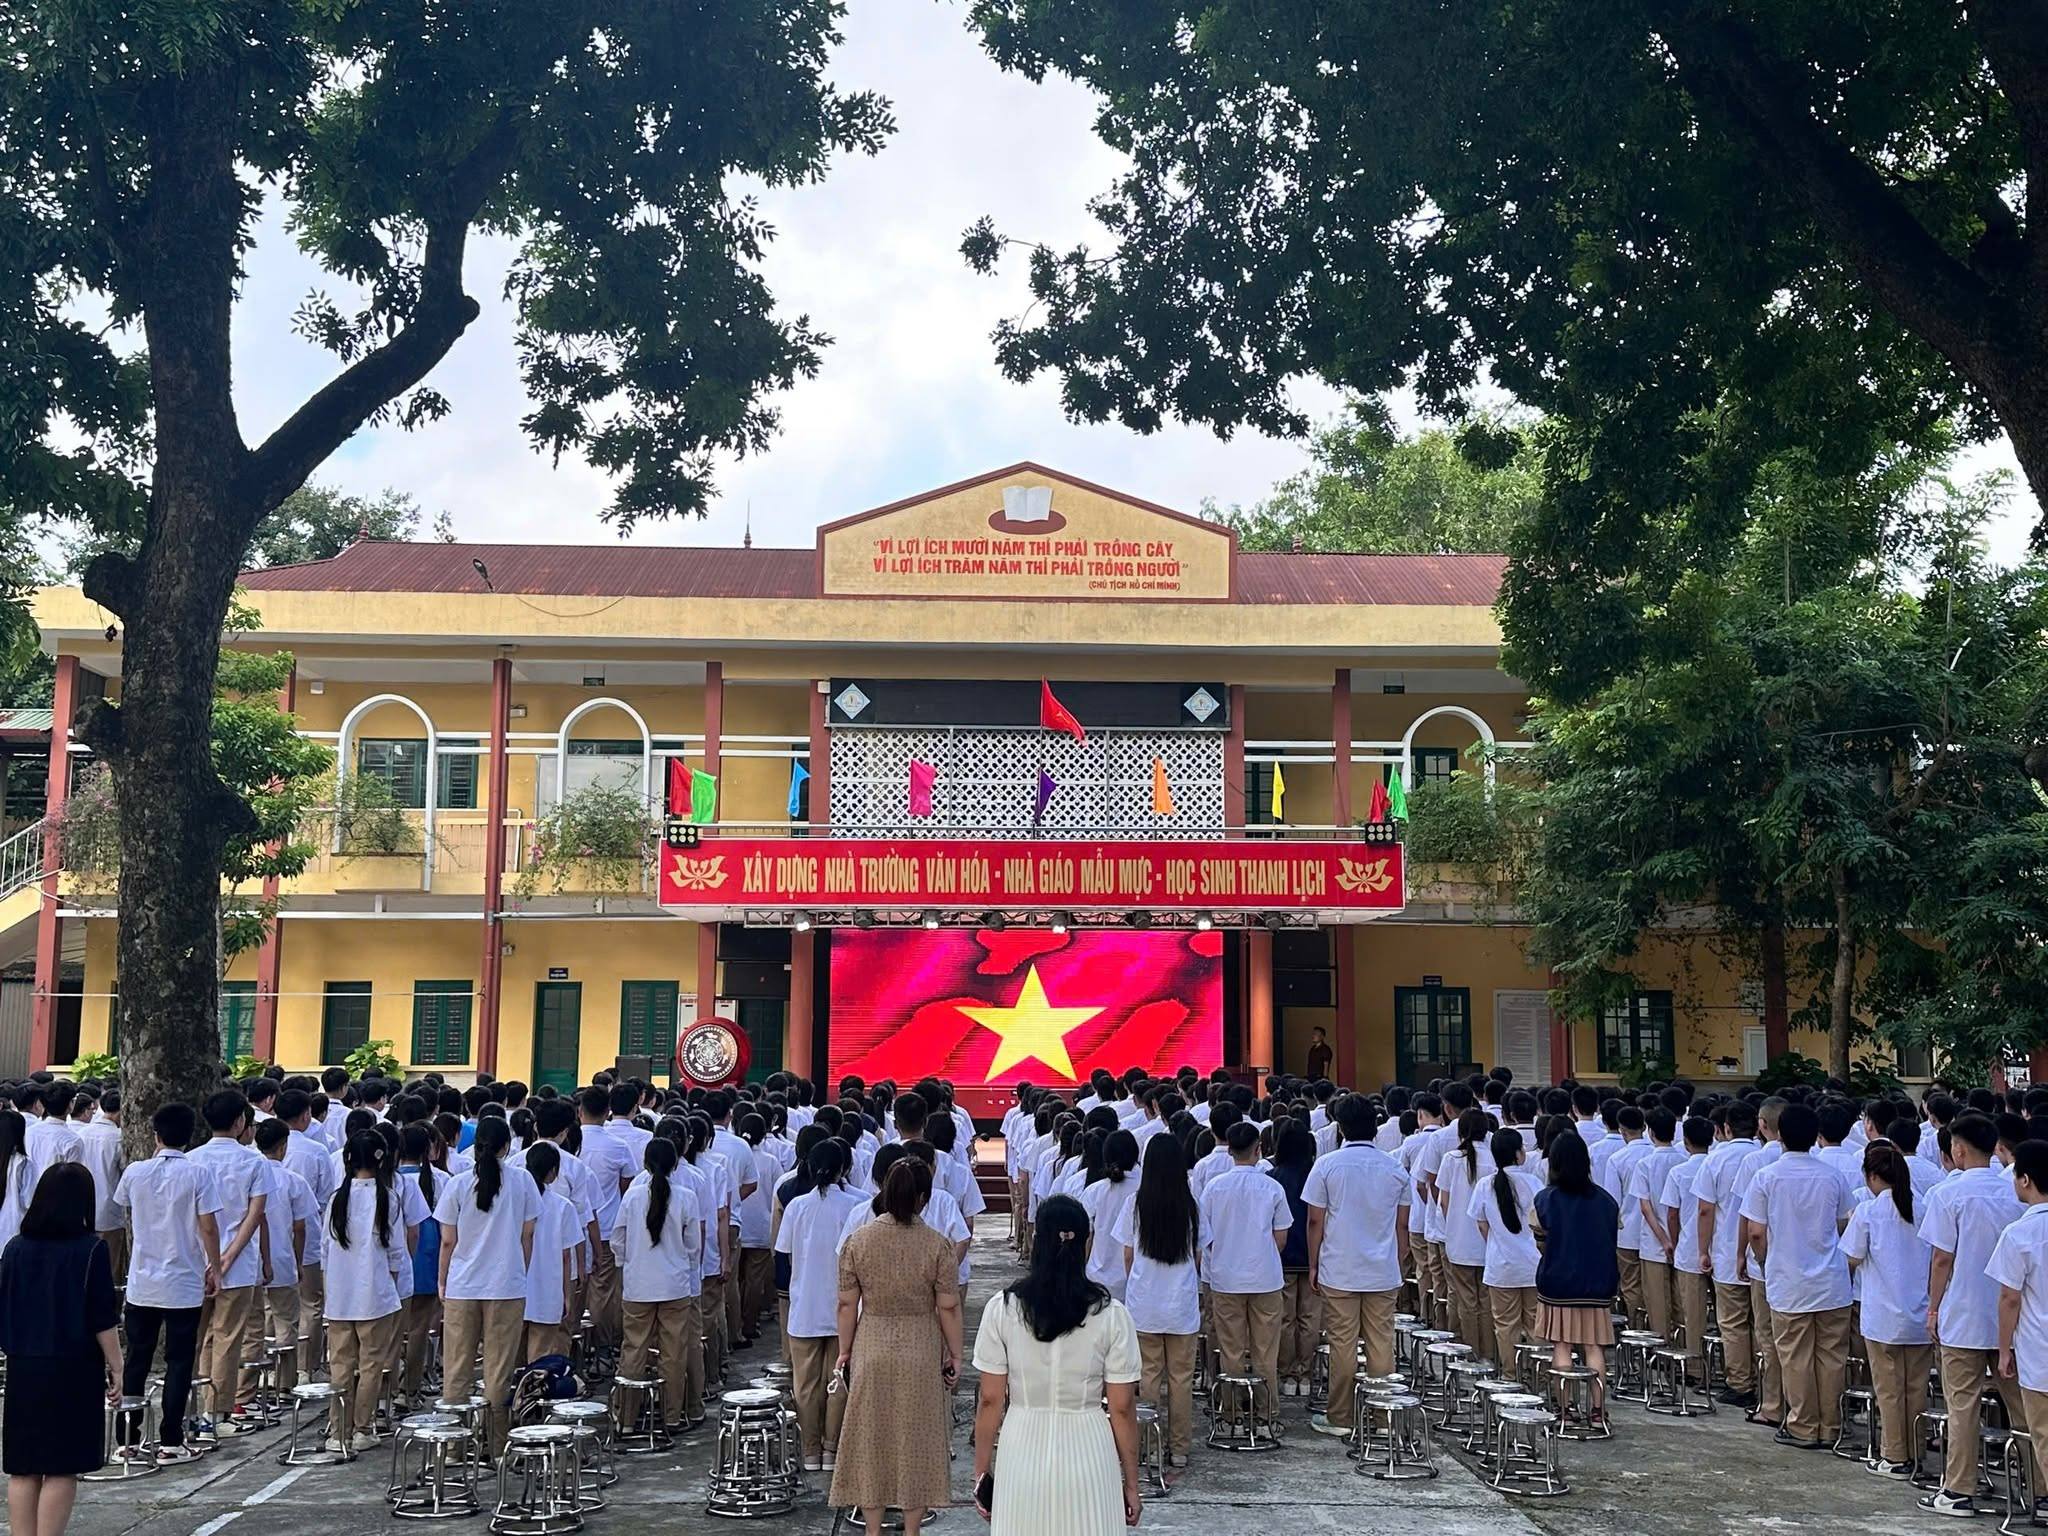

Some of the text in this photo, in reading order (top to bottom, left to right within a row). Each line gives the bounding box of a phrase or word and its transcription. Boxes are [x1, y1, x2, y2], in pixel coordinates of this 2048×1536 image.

[924, 536, 948, 555] ÍCH
[952, 536, 989, 556] MƯỜI
[992, 538, 1025, 556] NĂM
[1146, 541, 1174, 557] CÂY
[918, 554, 942, 574] ÍCH
[945, 557, 984, 575] TRĂM
[988, 557, 1022, 575] NĂM
[742, 850, 773, 893] XÂY
[776, 853, 818, 899] DỰNG
[824, 850, 856, 893] NHÀ
[860, 848, 919, 894] TRƯỜNG
[926, 852, 956, 894] VĂN
[960, 850, 990, 894] HÓA
[1004, 850, 1035, 894] NHÀ
[1039, 851, 1074, 894] GIÁO
[1080, 848, 1114, 894] MẪU
[1119, 855, 1152, 901] MỰC
[1166, 859, 1196, 901] HỌC
[1200, 859, 1236, 895] SINH
[1239, 859, 1288, 895] THANH
[1292, 860, 1326, 902] LỊCH
